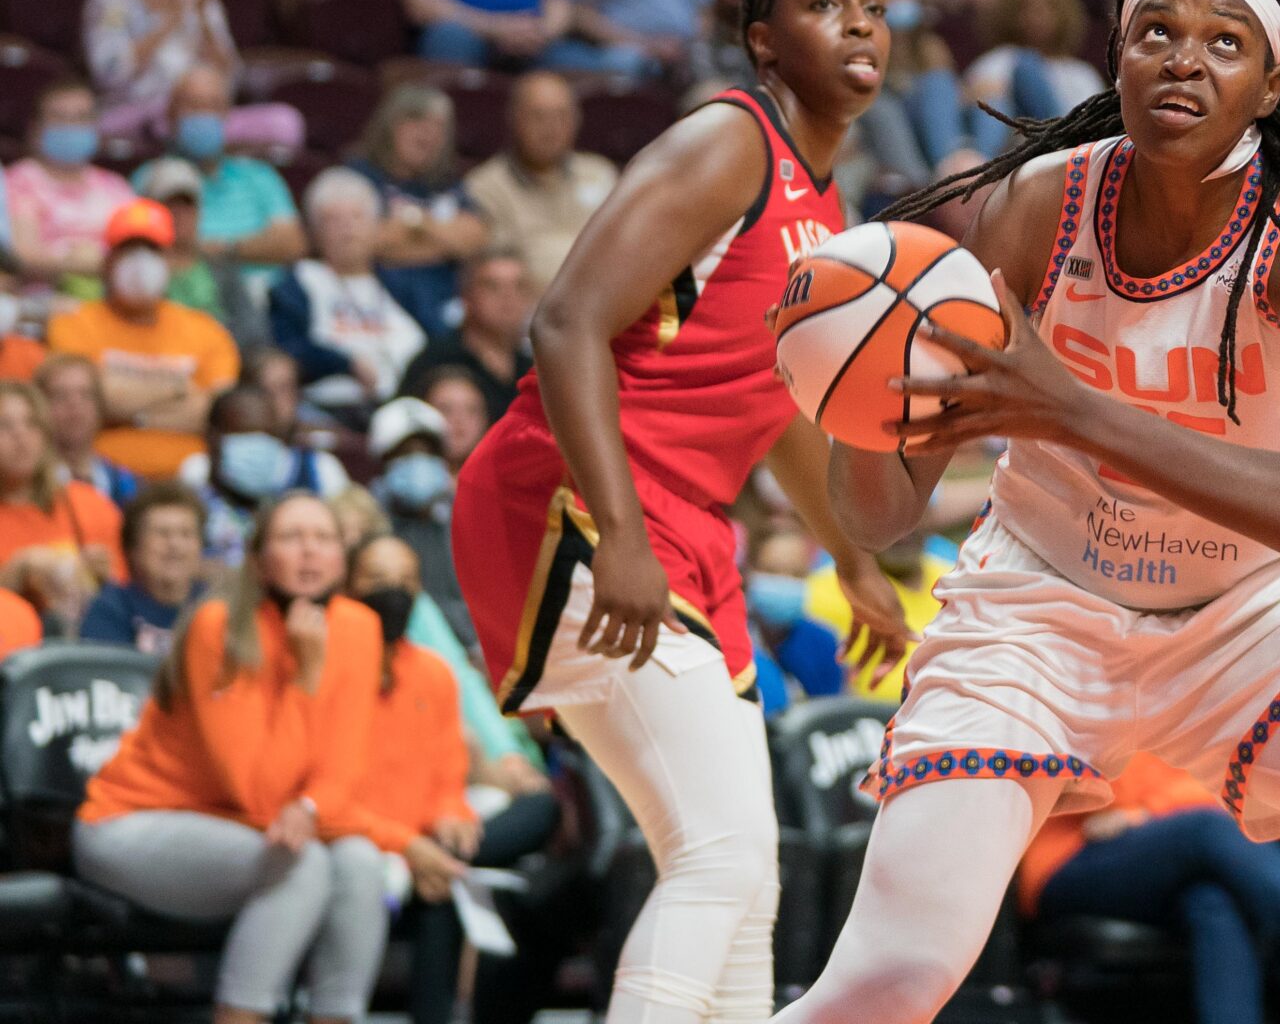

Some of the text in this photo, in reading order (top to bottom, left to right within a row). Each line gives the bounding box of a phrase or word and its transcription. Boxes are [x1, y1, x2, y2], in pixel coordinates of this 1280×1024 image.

[1052, 323, 1267, 403] SUN
[1082, 539, 1178, 585] Health
[1087, 511, 1238, 562] NewHaven
